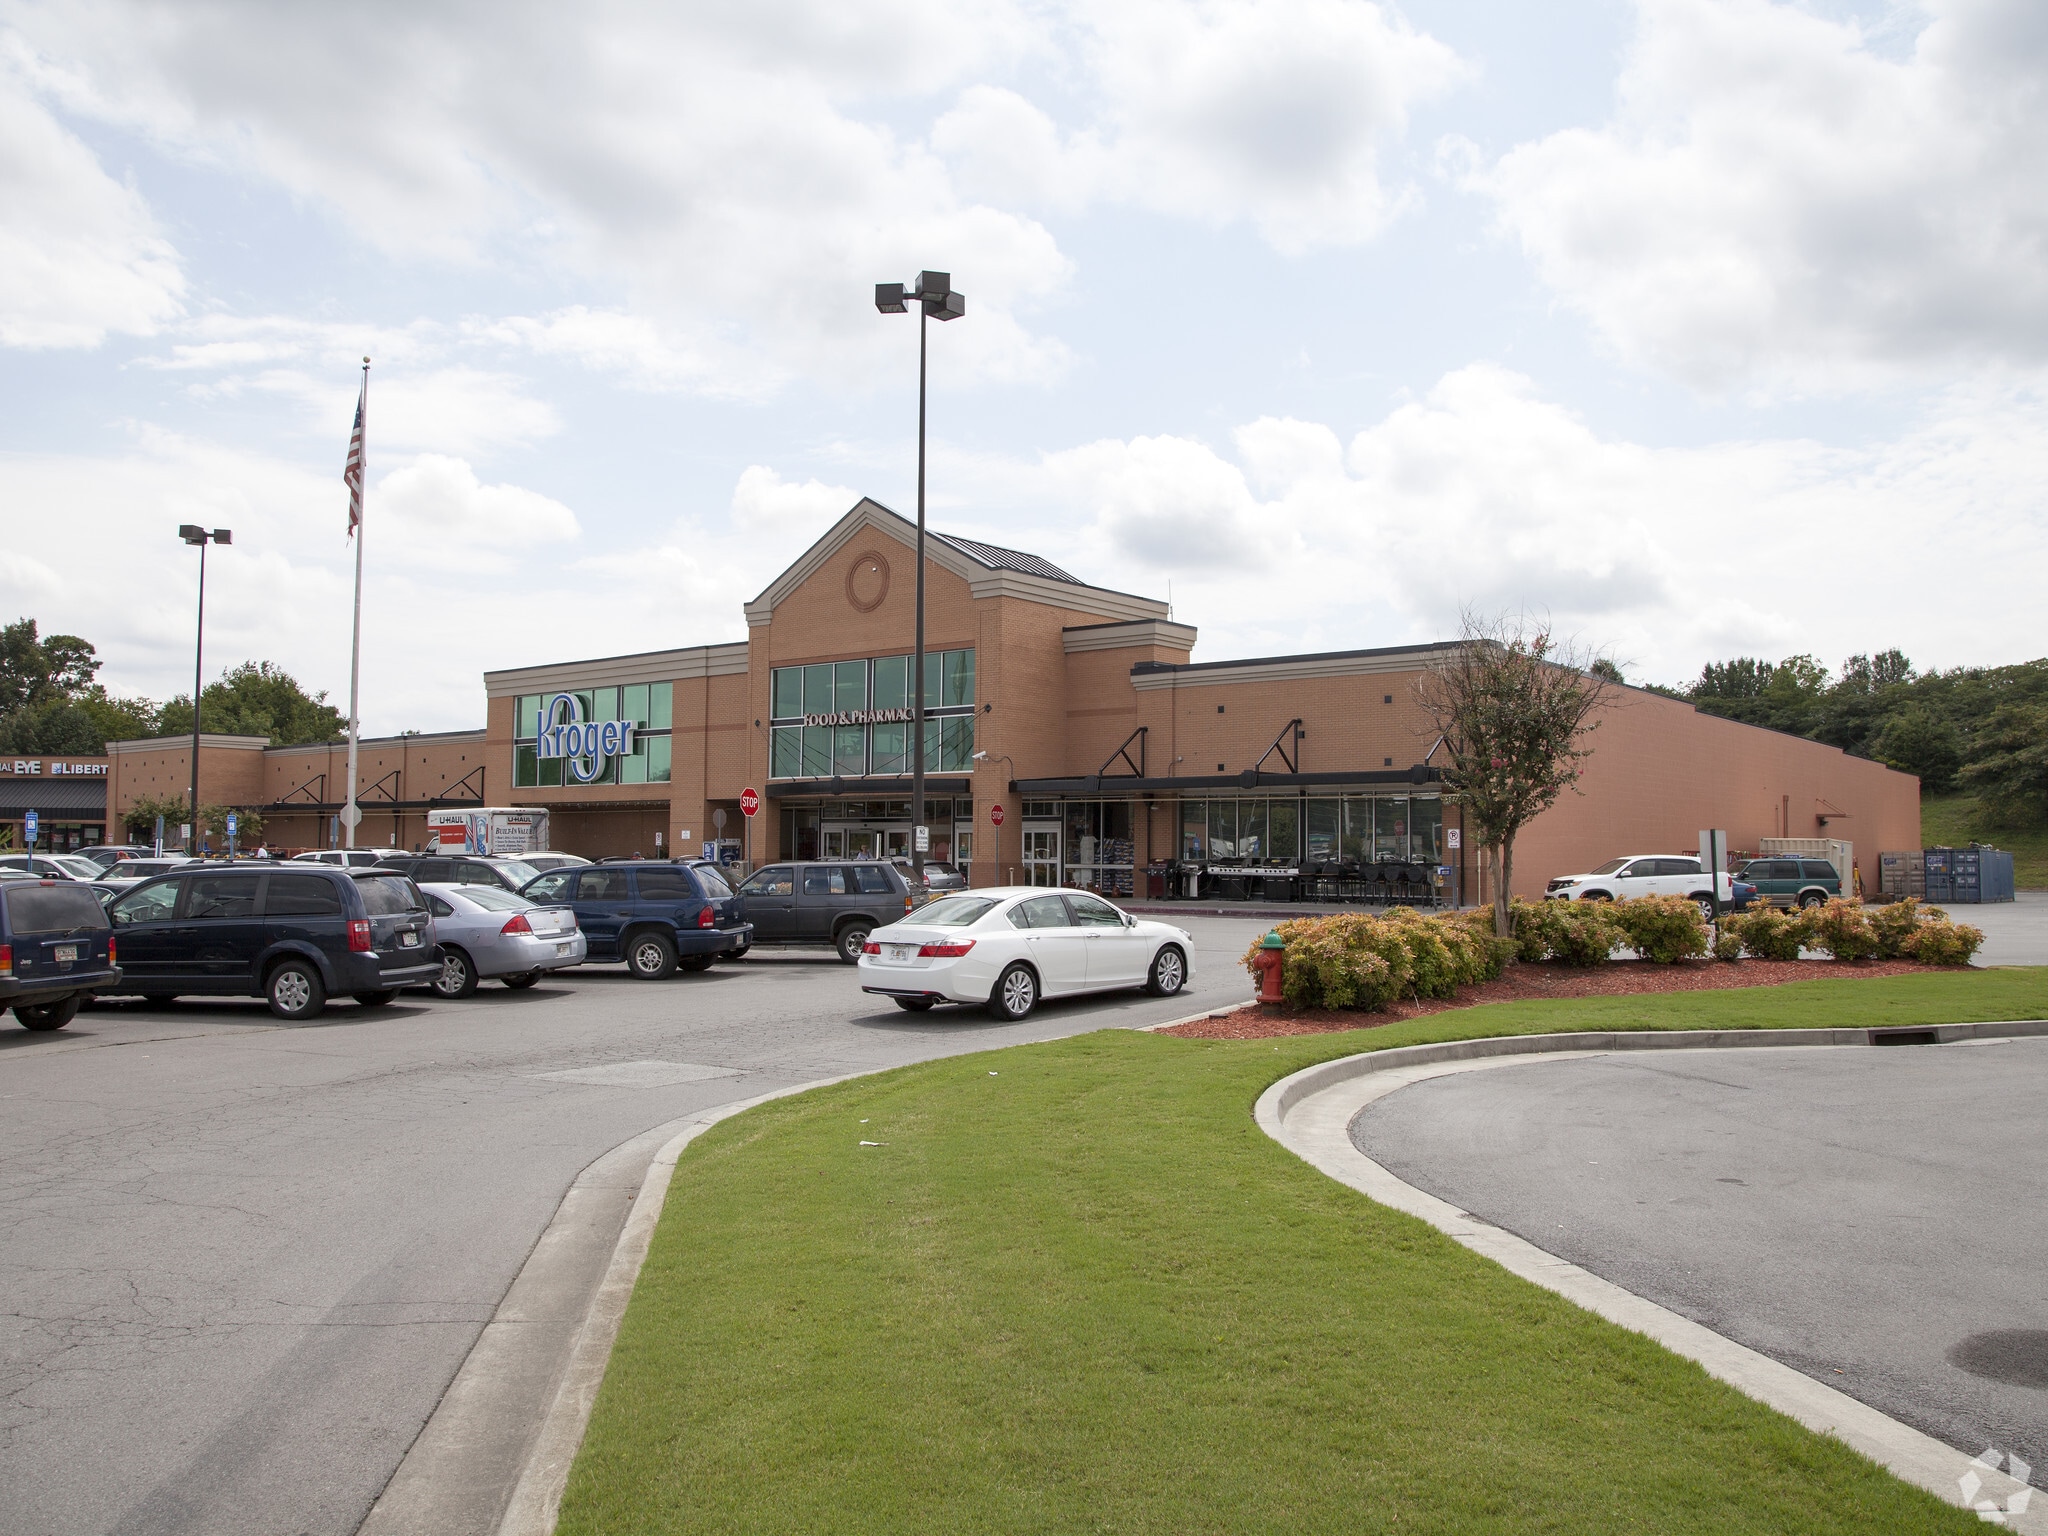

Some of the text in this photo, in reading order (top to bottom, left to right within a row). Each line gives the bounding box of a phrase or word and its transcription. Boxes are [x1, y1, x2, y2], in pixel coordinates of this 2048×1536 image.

[804, 713, 837, 726] FOOD
[840, 711, 851, 725] &
[537, 693, 632, 781] Kroger
[14, 760, 41, 774] EYE
[742, 796, 758, 808] STOP
[992, 811, 1004, 820] STOP
